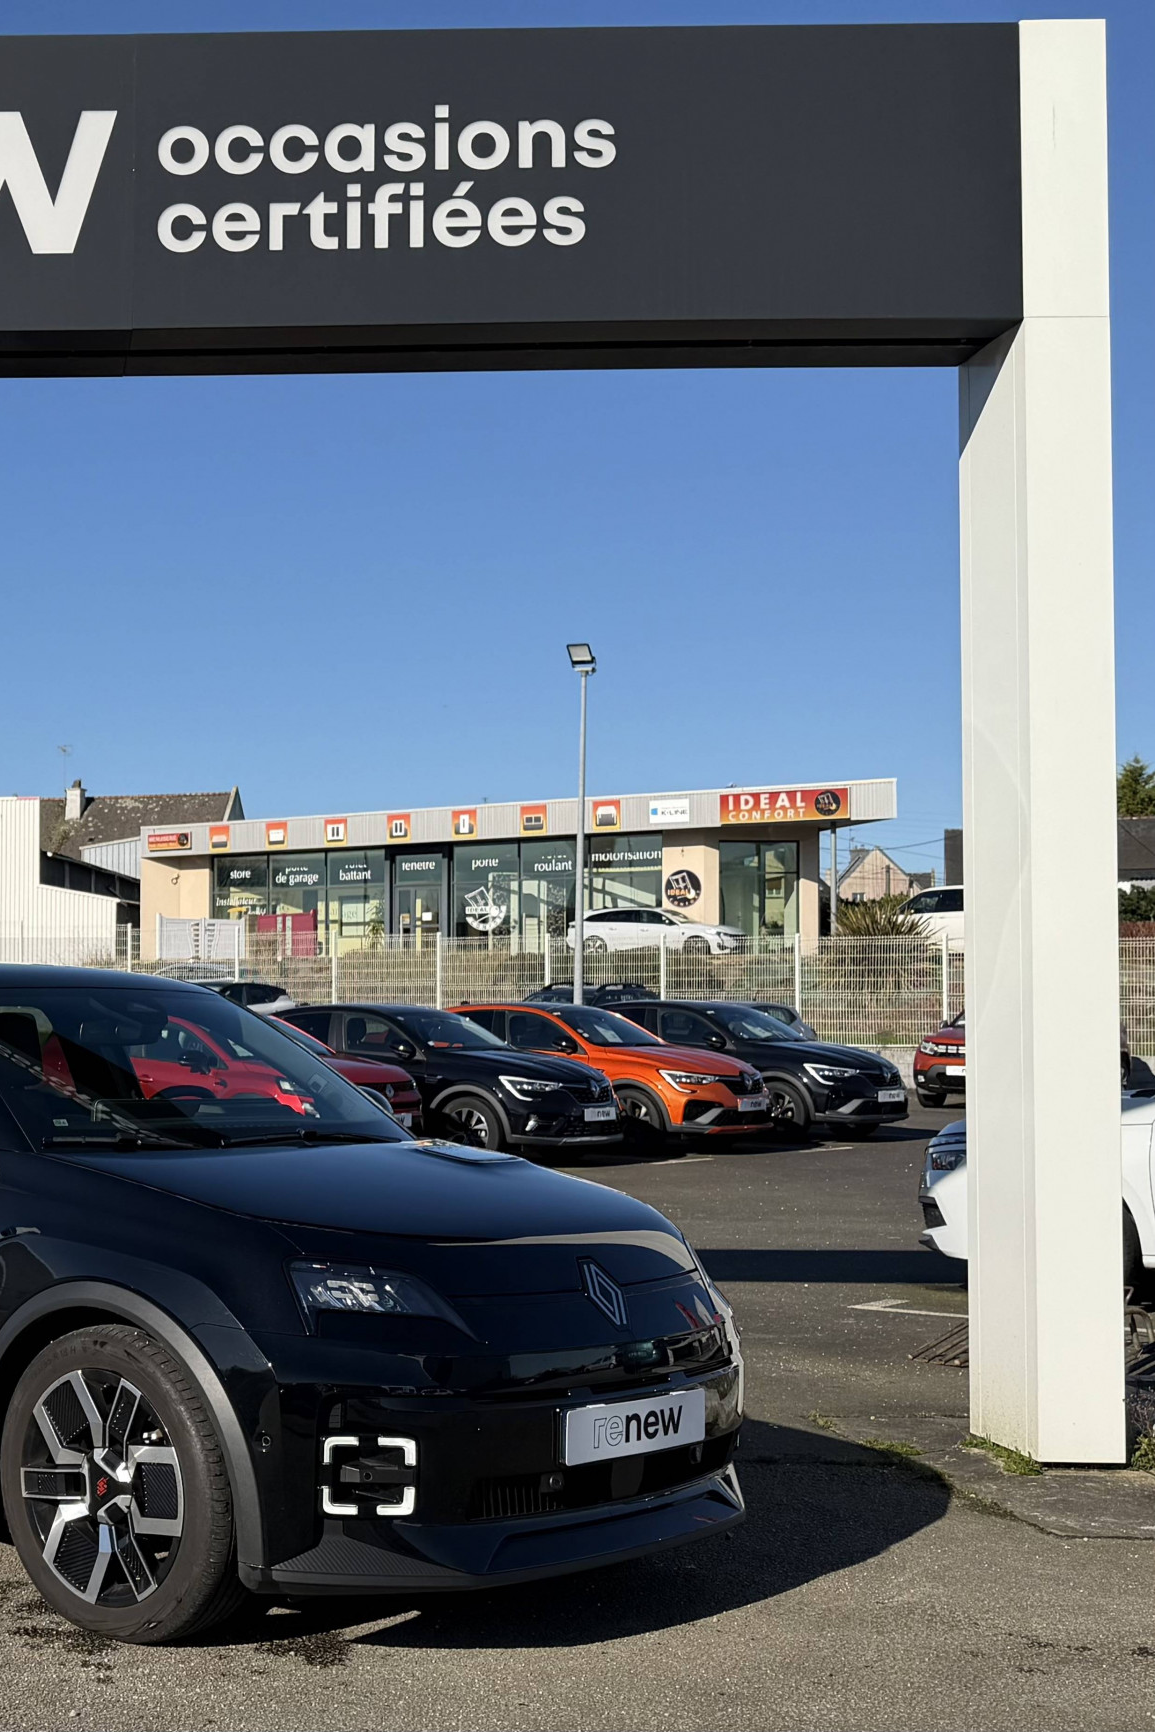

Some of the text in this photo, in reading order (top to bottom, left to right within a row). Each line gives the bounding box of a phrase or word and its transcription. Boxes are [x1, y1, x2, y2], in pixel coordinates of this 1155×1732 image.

[157, 104, 617, 176] occasions
[157, 181, 586, 253] certifiées
[728, 792, 806, 811] IDEAL
[729, 808, 806, 821] CONFORT
[534, 859, 572, 871] roulant
[230, 869, 251, 879] store
[275, 872, 319, 886] de garage
[339, 869, 371, 881] battant
[593, 1404, 683, 1449] renew
